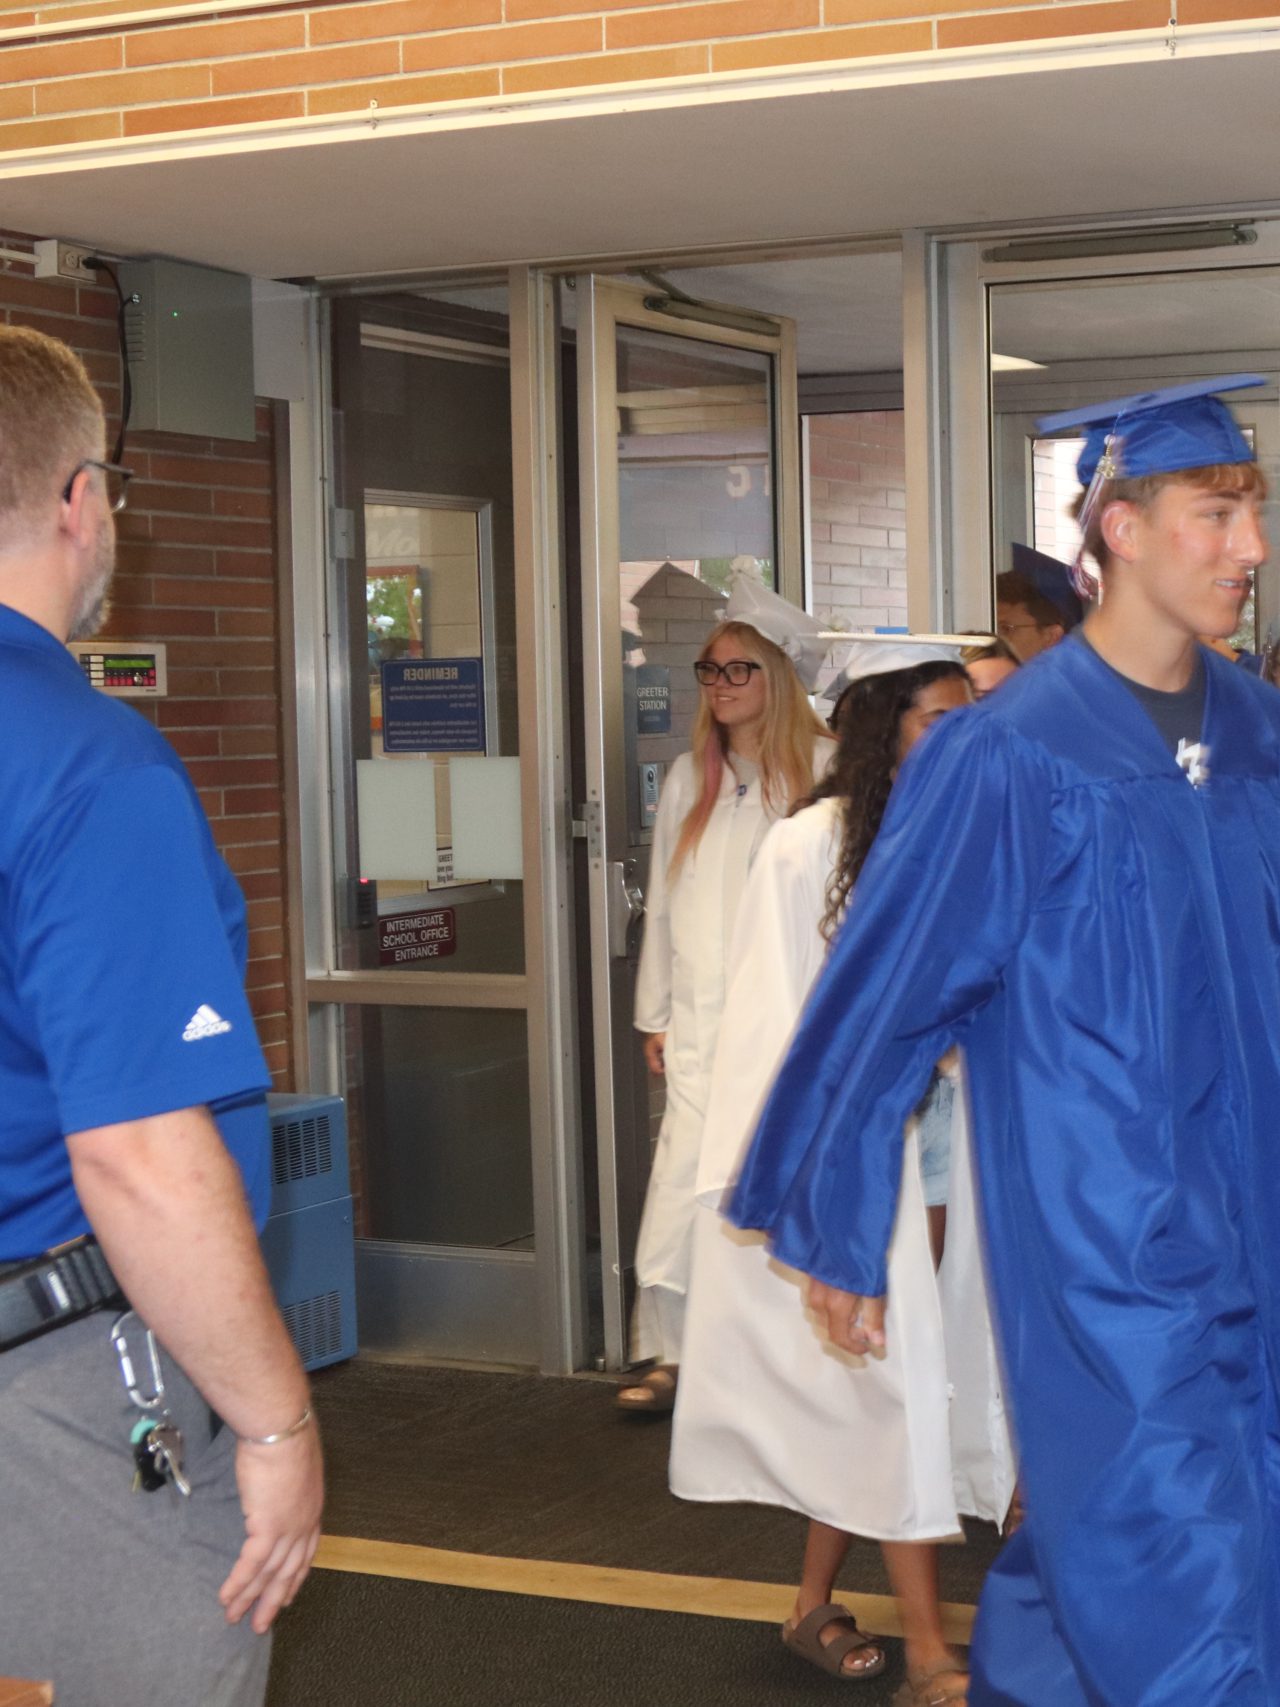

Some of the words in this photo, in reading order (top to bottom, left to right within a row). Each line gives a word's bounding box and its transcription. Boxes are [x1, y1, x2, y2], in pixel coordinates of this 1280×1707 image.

[637, 687, 669, 697] GREETER
[639, 700, 667, 711] STATION
[386, 914, 444, 933] INTERMEDIATE
[383, 932, 418, 947] SCHOOL
[420, 927, 449, 941] OFFICE
[395, 944, 439, 961] ENTRANCE
